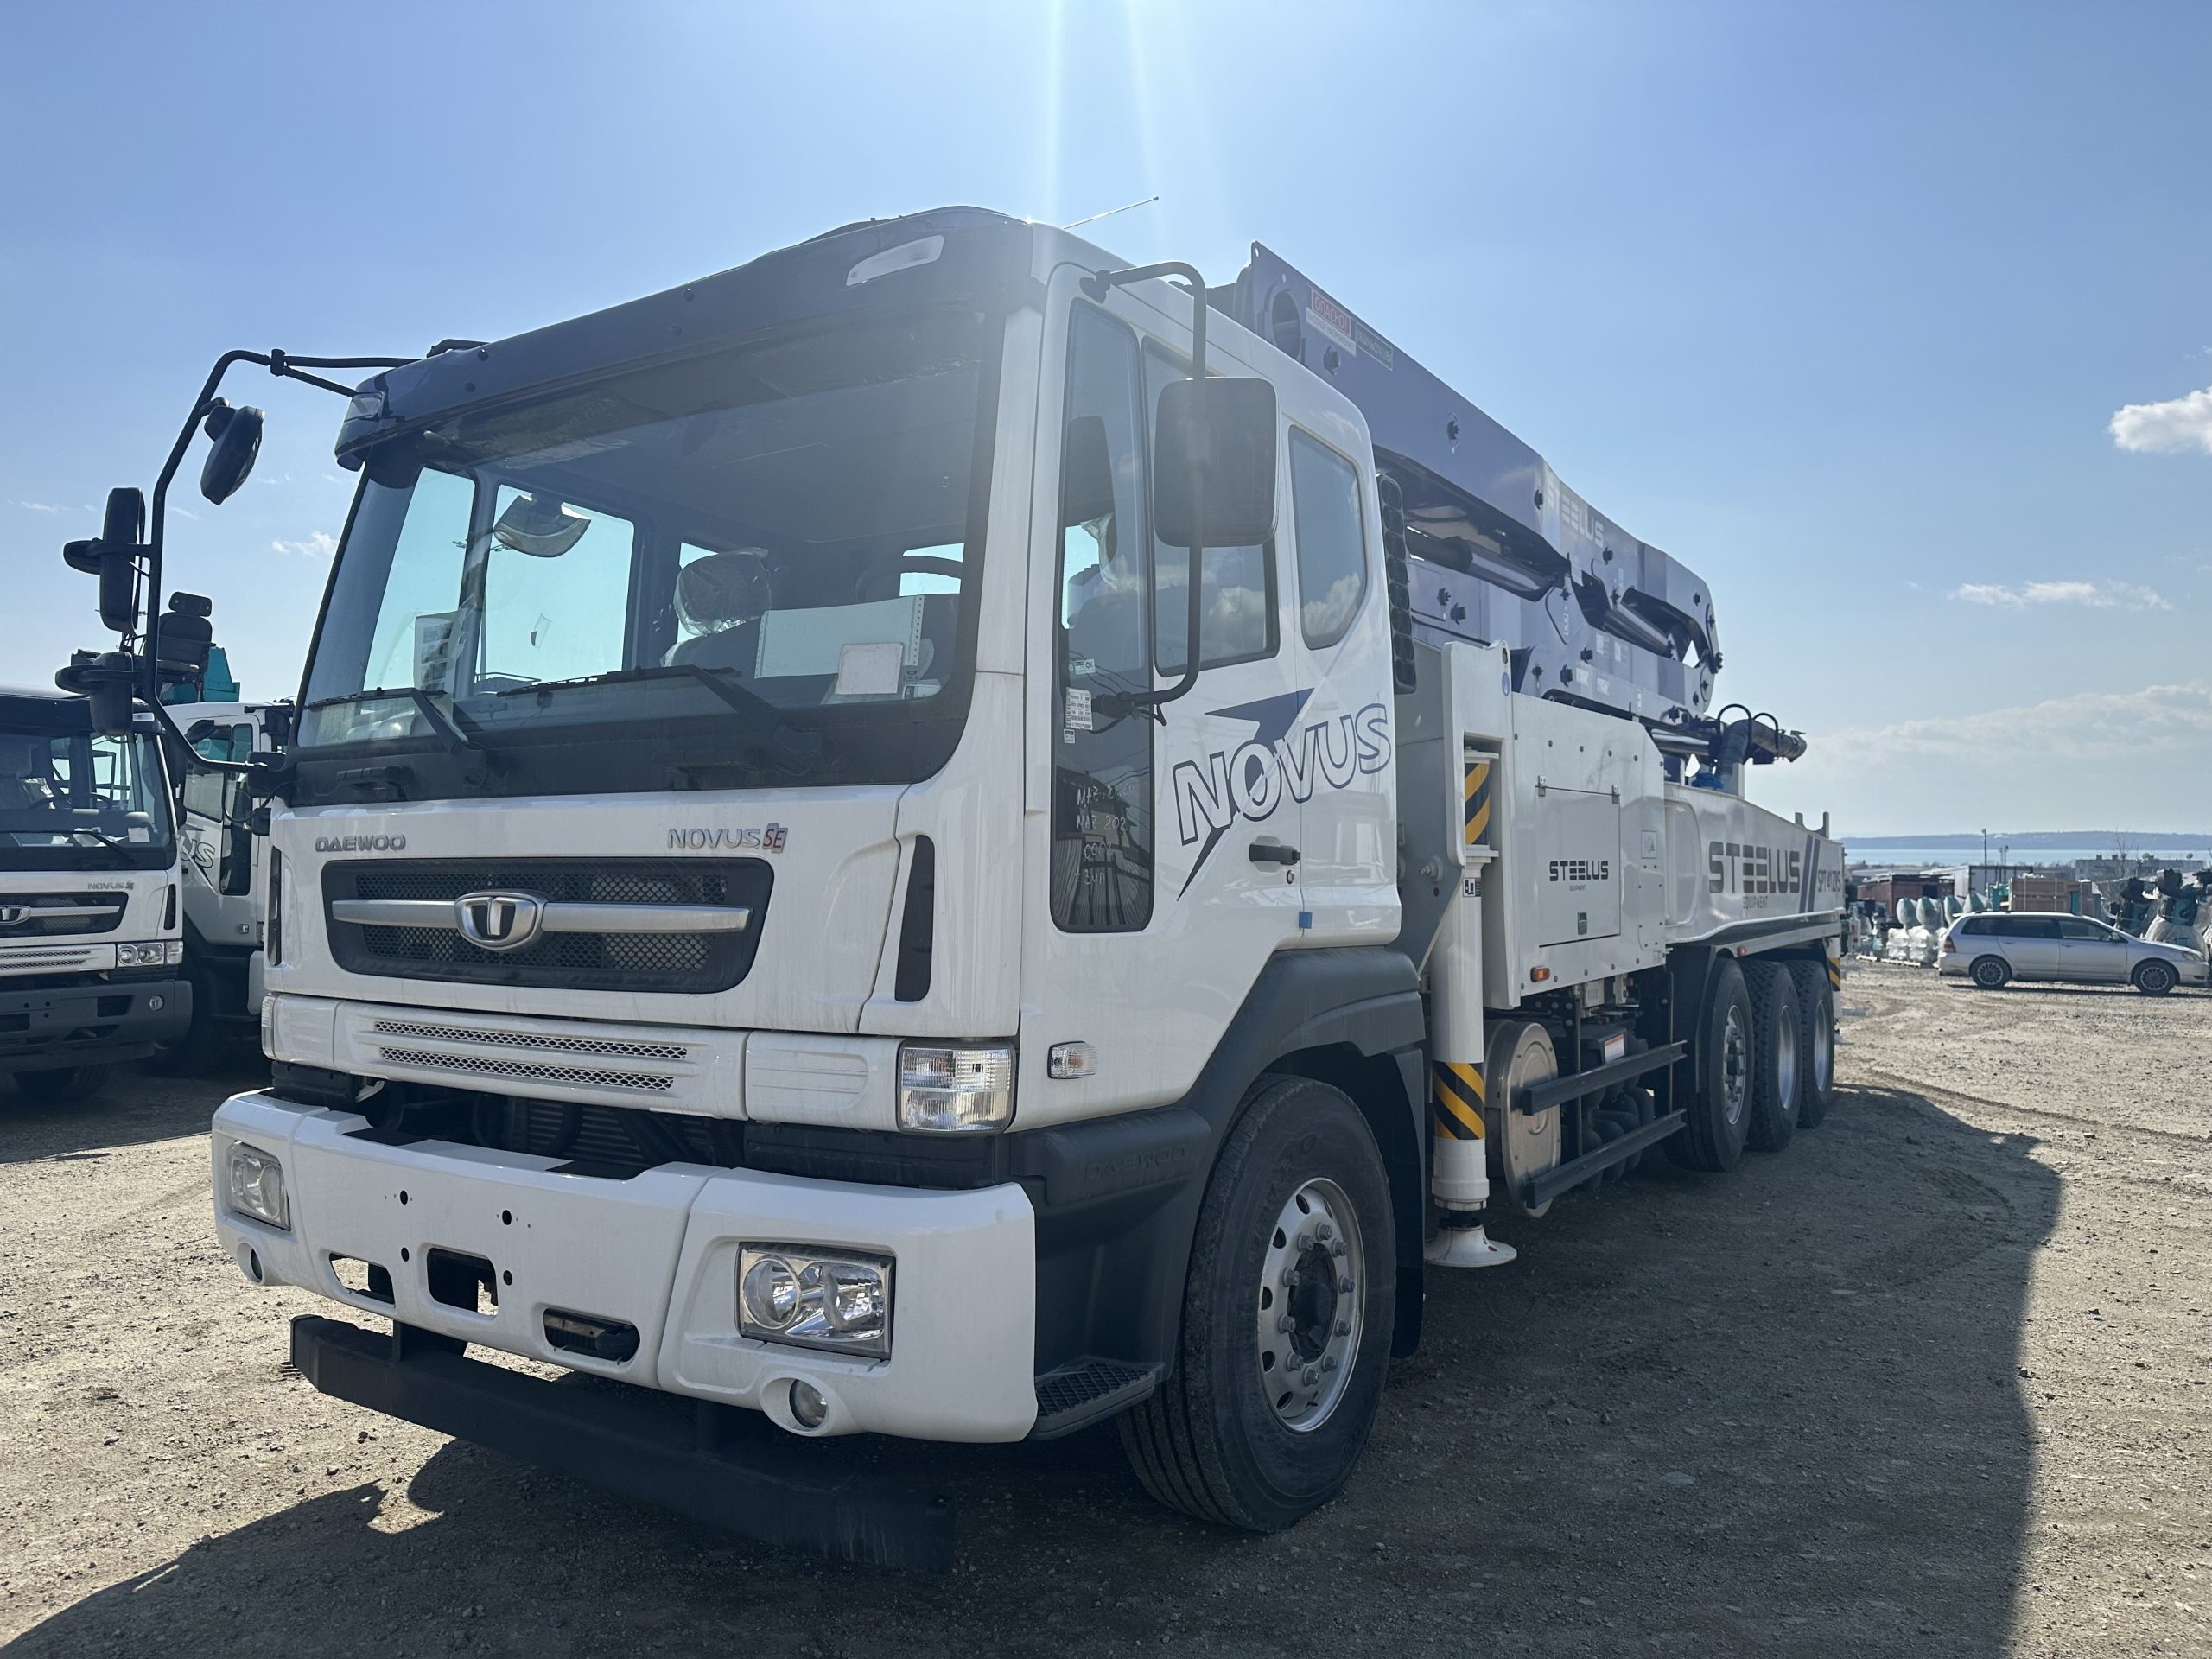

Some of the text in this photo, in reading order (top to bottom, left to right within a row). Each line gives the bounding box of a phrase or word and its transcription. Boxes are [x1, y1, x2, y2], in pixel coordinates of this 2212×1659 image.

[1314, 296, 1348, 330] ОПАСНО!
[1547, 474, 1605, 548] STEELUS
[1173, 703, 1392, 846] NOVUS
[315, 834, 406, 852] DAEWOO
[667, 828, 785, 849] NOVUS SE
[1549, 860, 1609, 882] STEELUS
[1709, 841, 1800, 893] STEELUS
[87, 882, 124, 891] NOVUS
